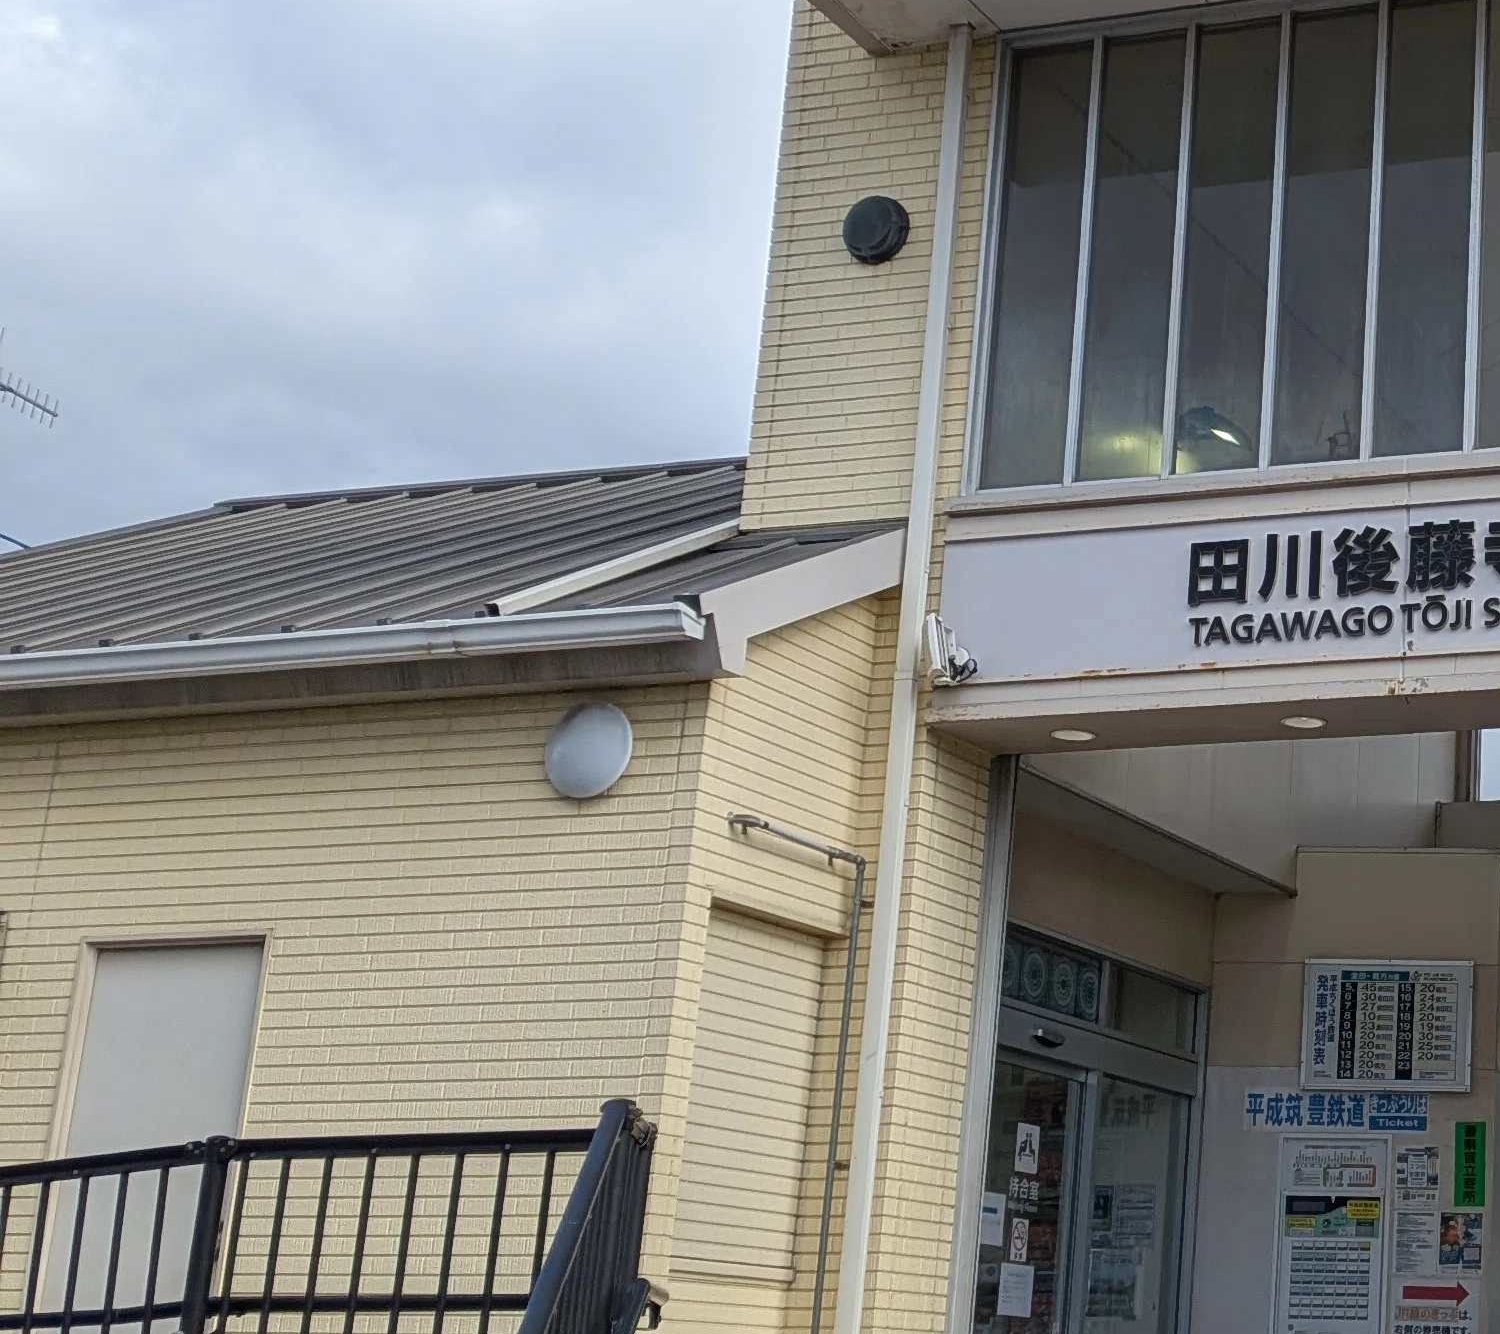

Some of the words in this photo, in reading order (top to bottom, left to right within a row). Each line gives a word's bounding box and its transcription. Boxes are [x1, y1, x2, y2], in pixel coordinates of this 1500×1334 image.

[1345, 993, 1351, 1001] 6
[1420, 1003, 1435, 1011] 24
[1313, 975, 1328, 1065] 発車時刻表
[1362, 1012, 1375, 1020] 10
[1419, 1013, 1434, 1021] 20
[1360, 1022, 1375, 1030] 23
[1360, 1032, 1375, 1040] 20
[1398, 1032, 1410, 1040] 20
[1419, 1032, 1433, 1040] 30
[1360, 1041, 1375, 1049] 20
[1399, 1042, 1409, 1050] 21
[1419, 1042, 1433, 1050] 25
[1359, 1051, 1374, 1059] 20
[1418, 1052, 1433, 1060] 20
[1358, 1070, 1373, 1078] 20
[1246, 1093, 1366, 1127] 平成筑豊鉄道
[1376, 1118, 1418, 1127] Ticket
[1009, 1176, 1040, 1201] 待合室
